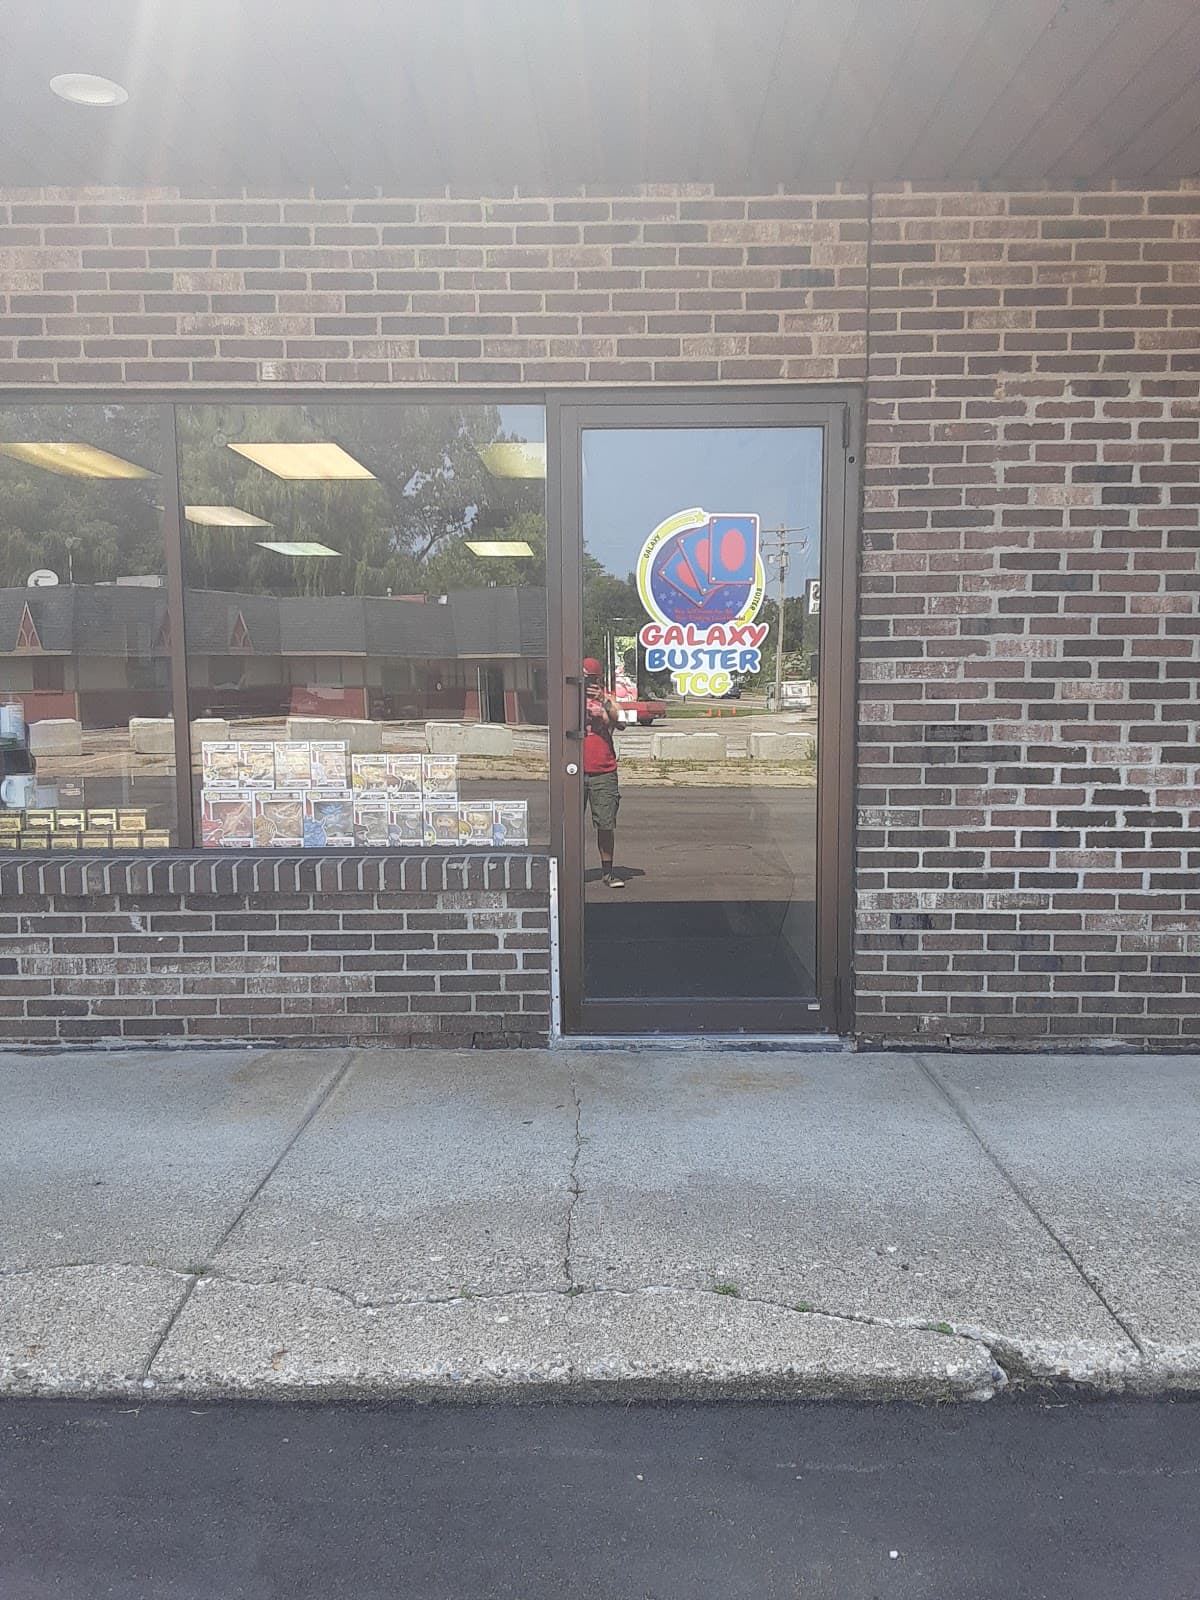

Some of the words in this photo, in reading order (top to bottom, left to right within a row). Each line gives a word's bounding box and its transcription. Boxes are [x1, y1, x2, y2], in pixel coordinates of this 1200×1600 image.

[643, 533, 660, 559] GALAXY
[750, 587, 762, 611] BUSTER
[641, 624, 767, 648] GALAXY
[648, 648, 760, 671] BUSTER
[673, 672, 731, 694] TCG
